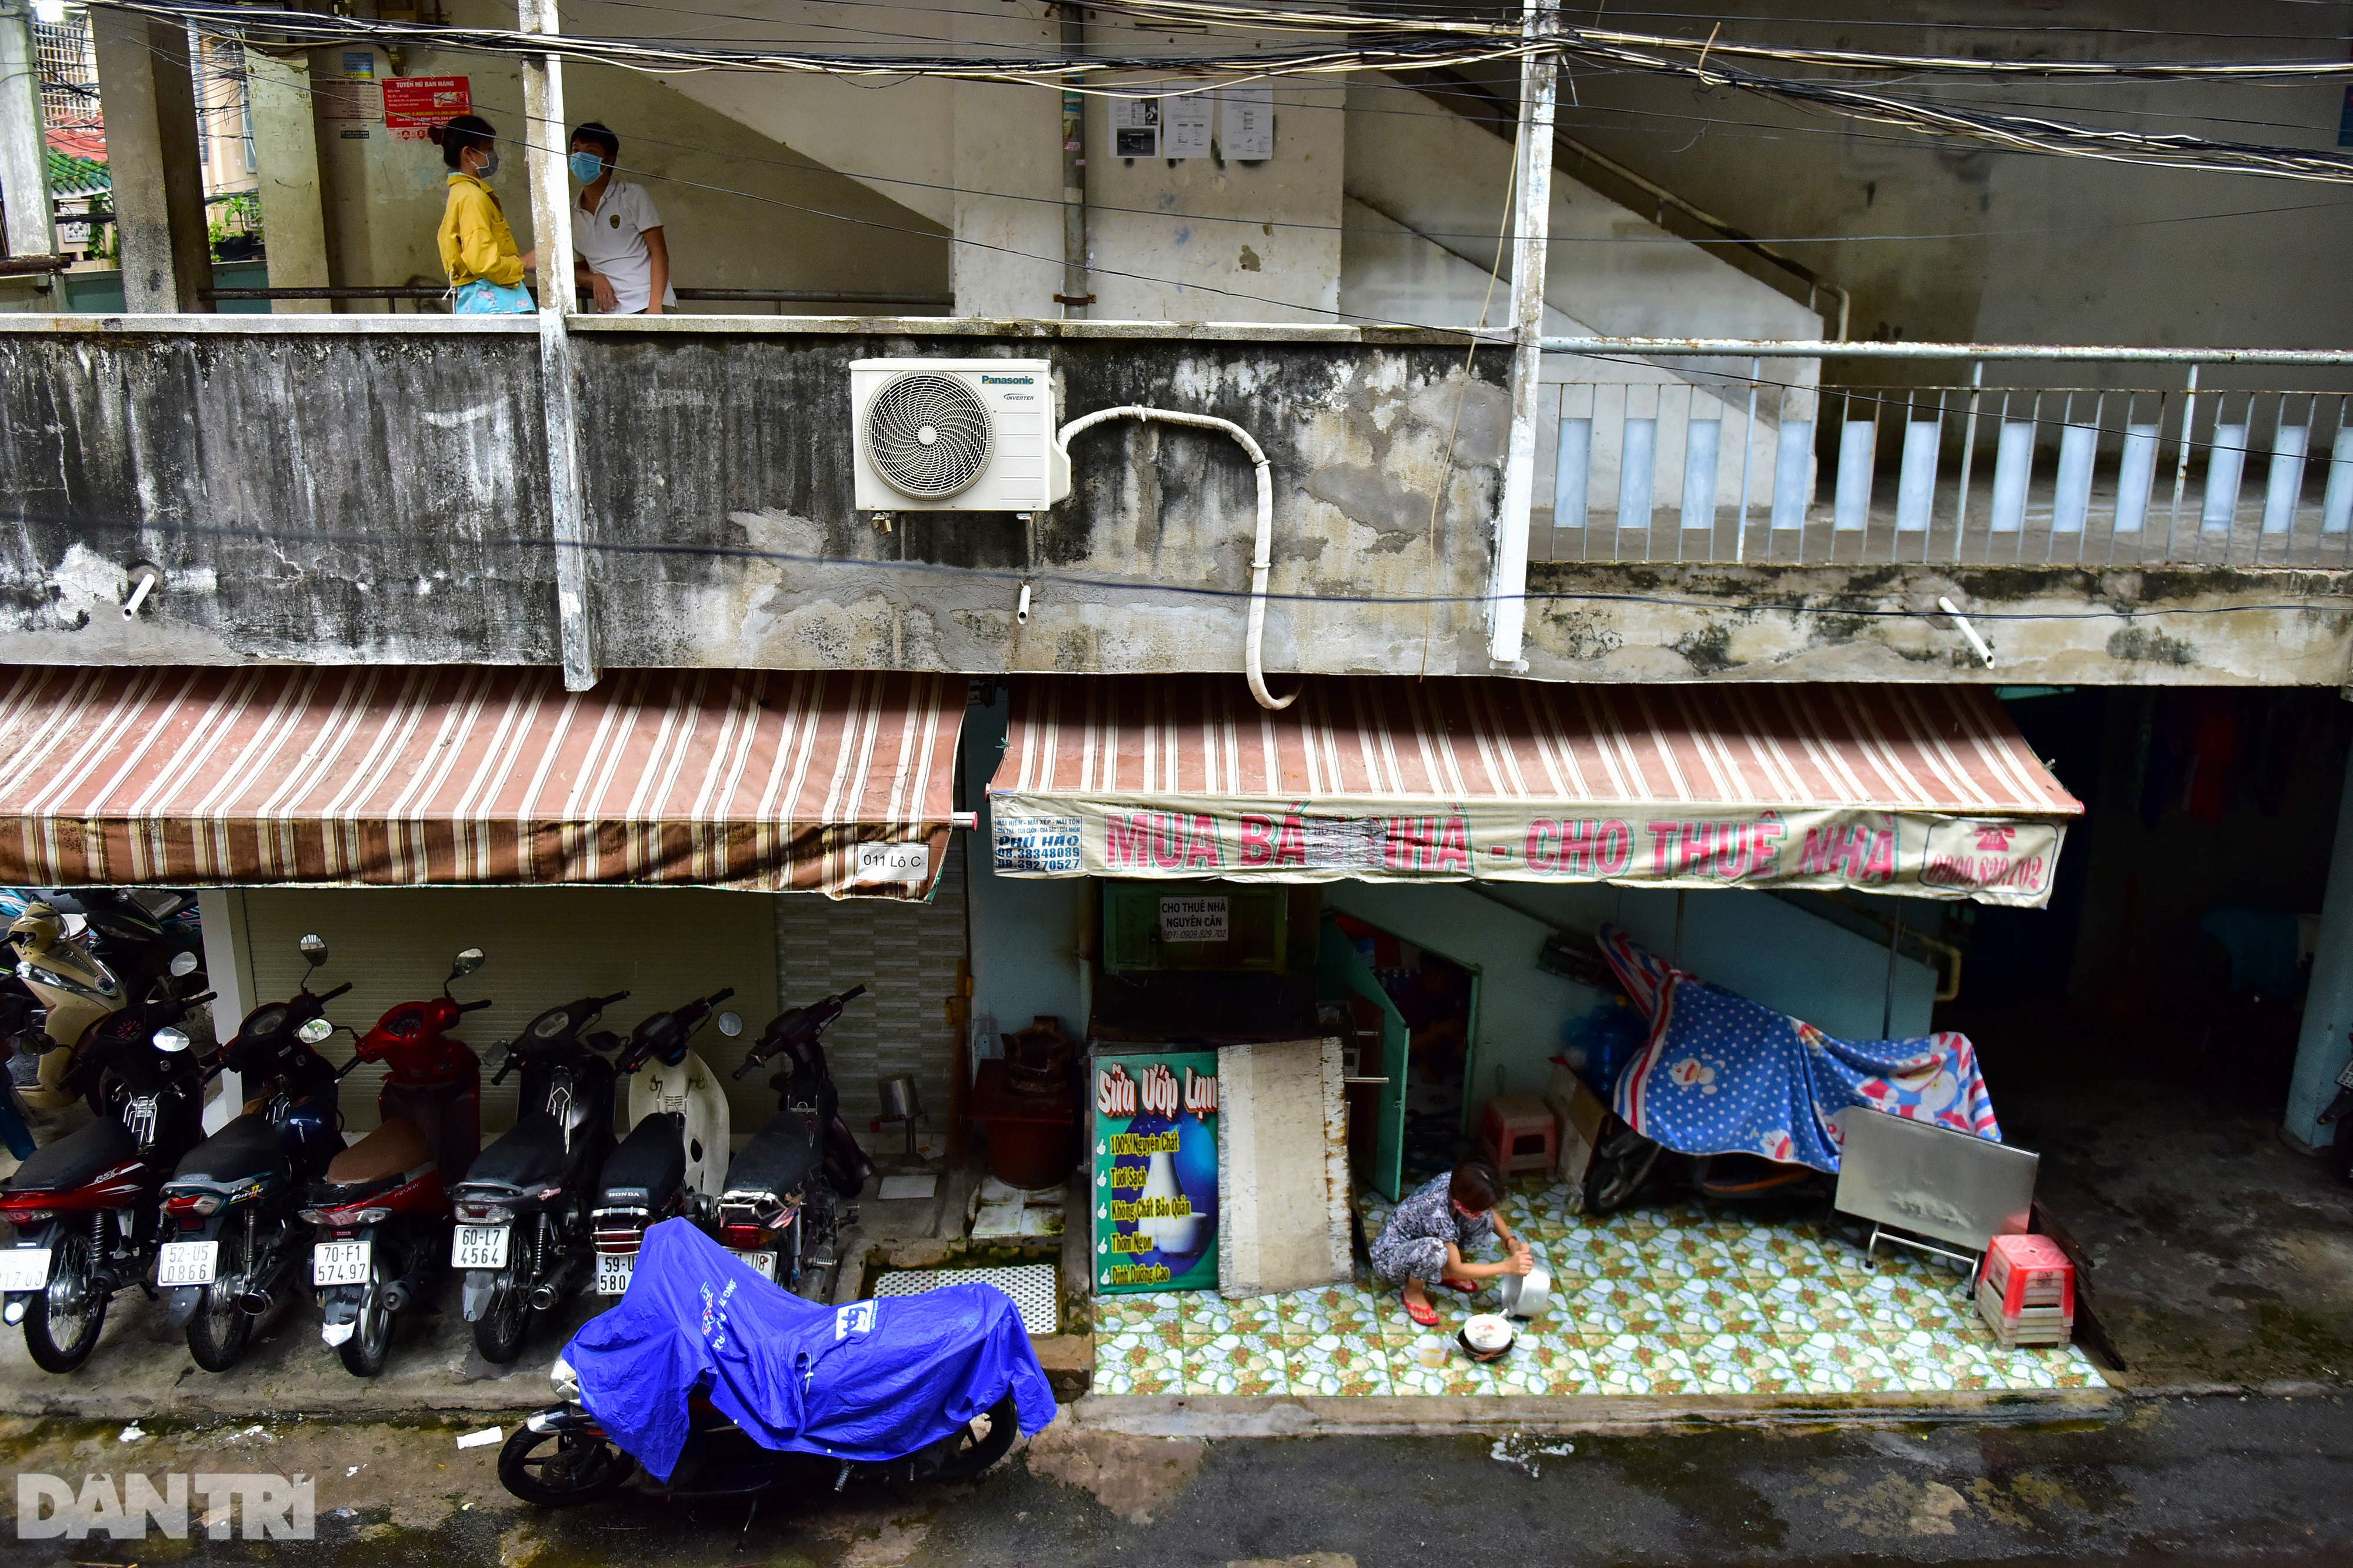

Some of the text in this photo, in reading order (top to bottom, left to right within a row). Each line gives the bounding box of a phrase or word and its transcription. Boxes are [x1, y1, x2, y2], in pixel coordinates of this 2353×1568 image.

[981, 375, 1034, 385] Panasonic
[999, 833, 1079, 848] PHÚ HÀO
[1104, 813, 1225, 870] MUA
[1524, 816, 1634, 878] CHO
[1646, 808, 1788, 880] THUÊ
[1796, 815, 1901, 882] NHÀ
[864, 855, 921, 868] 011 Lô C
[1162, 899, 1226, 913] CHO THUÊ NHÀ
[1166, 915, 1222, 928] NGUYÊN CĂN
[1181, 929, 1226, 939] 0909.829.702
[1098, 1063, 1136, 1116] Sữa
[1142, 1063, 1178, 1120] Ướp
[1110, 1130, 1179, 1156] 100% Nguyên Chất
[1110, 1166, 1147, 1190] Tươi Sạch
[1111, 1195, 1191, 1223] Không Chất Bảo Quản
[462, 1229, 501, 1246] 60-L7
[1111, 1231, 1153, 1255] Thơm Ngon
[169, 1245, 209, 1263] 52-U5
[325, 1245, 359, 1262] 70-F1
[461, 1247, 498, 1264] 4564
[168, 1264, 206, 1282] 0866
[318, 1263, 365, 1281] 574.97
[1111, 1262, 1170, 1286] Dinh Dưỡng Cao
